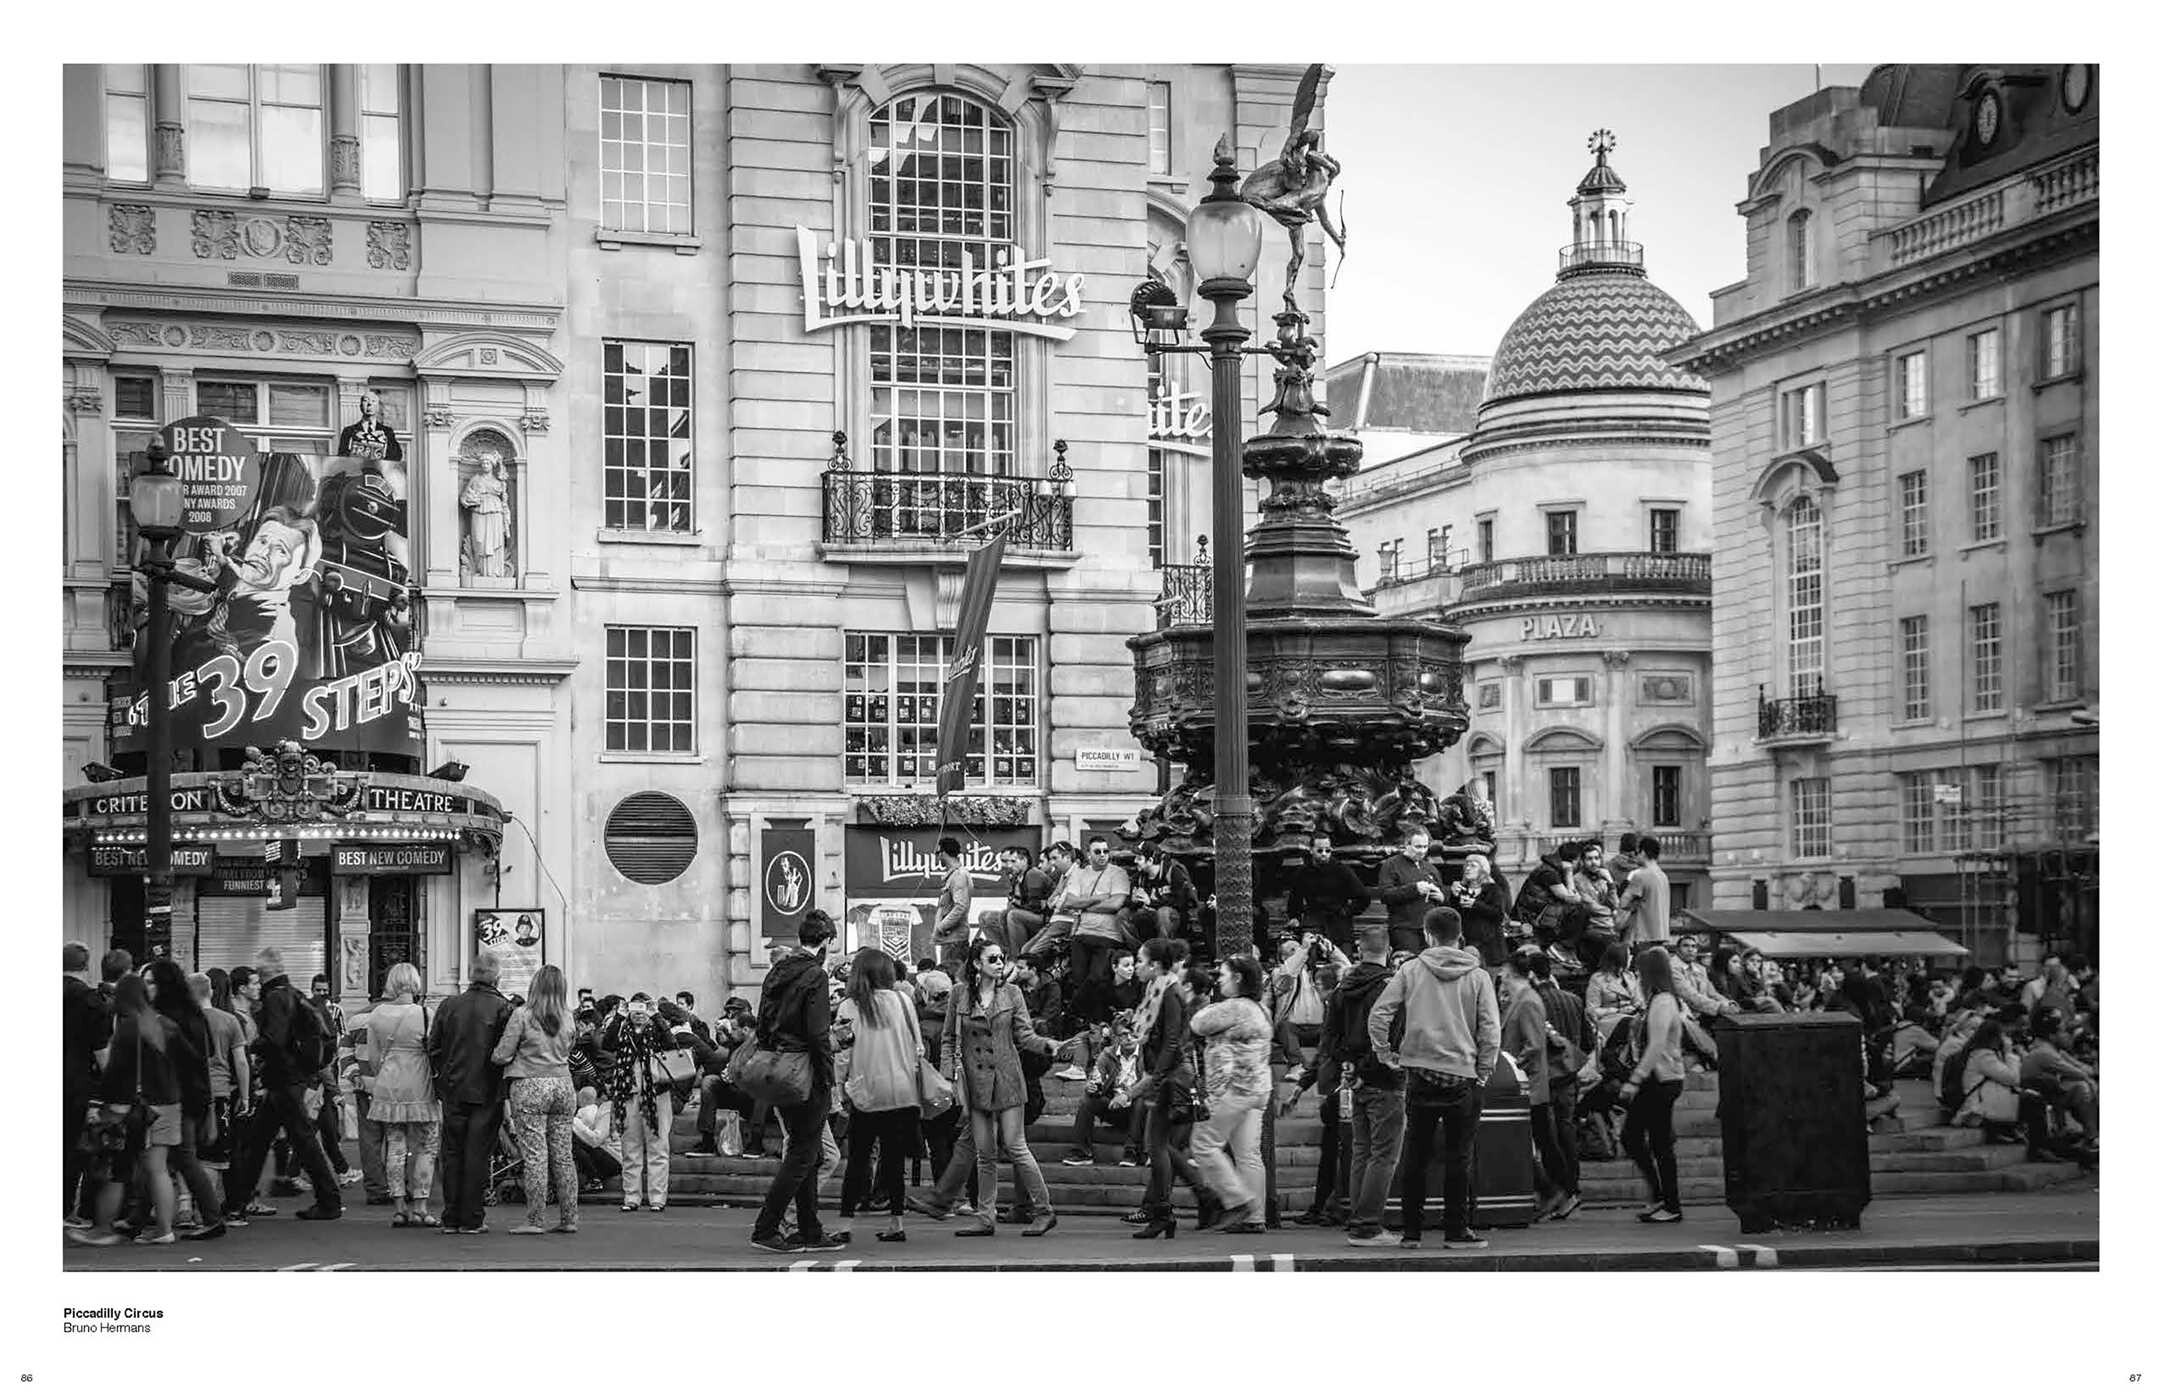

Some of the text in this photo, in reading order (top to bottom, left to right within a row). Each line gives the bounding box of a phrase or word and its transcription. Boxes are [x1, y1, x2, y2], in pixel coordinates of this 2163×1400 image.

[796, 224, 1087, 341] Lillywhites
[173, 427, 226, 453] BEST
[163, 455, 247, 481] OMEDY
[191, 485, 223, 497] AWARD
[224, 485, 248, 497] 2007
[197, 498, 236, 510] AWARDS
[188, 511, 212, 523] 2008
[1520, 614, 1599, 641] PLAZA
[197, 640, 298, 740] 39
[1081, 751, 1135, 761] PICCADILLY W1
[96, 788, 454, 814] CRITEON THEATRE
[95, 851, 123, 866] BEST
[170, 850, 208, 866] MEDY
[339, 850, 446, 866] BEST NEW COMEDY
[223, 879, 264, 892] FUNNIEST
[480, 919, 503, 942] 39
